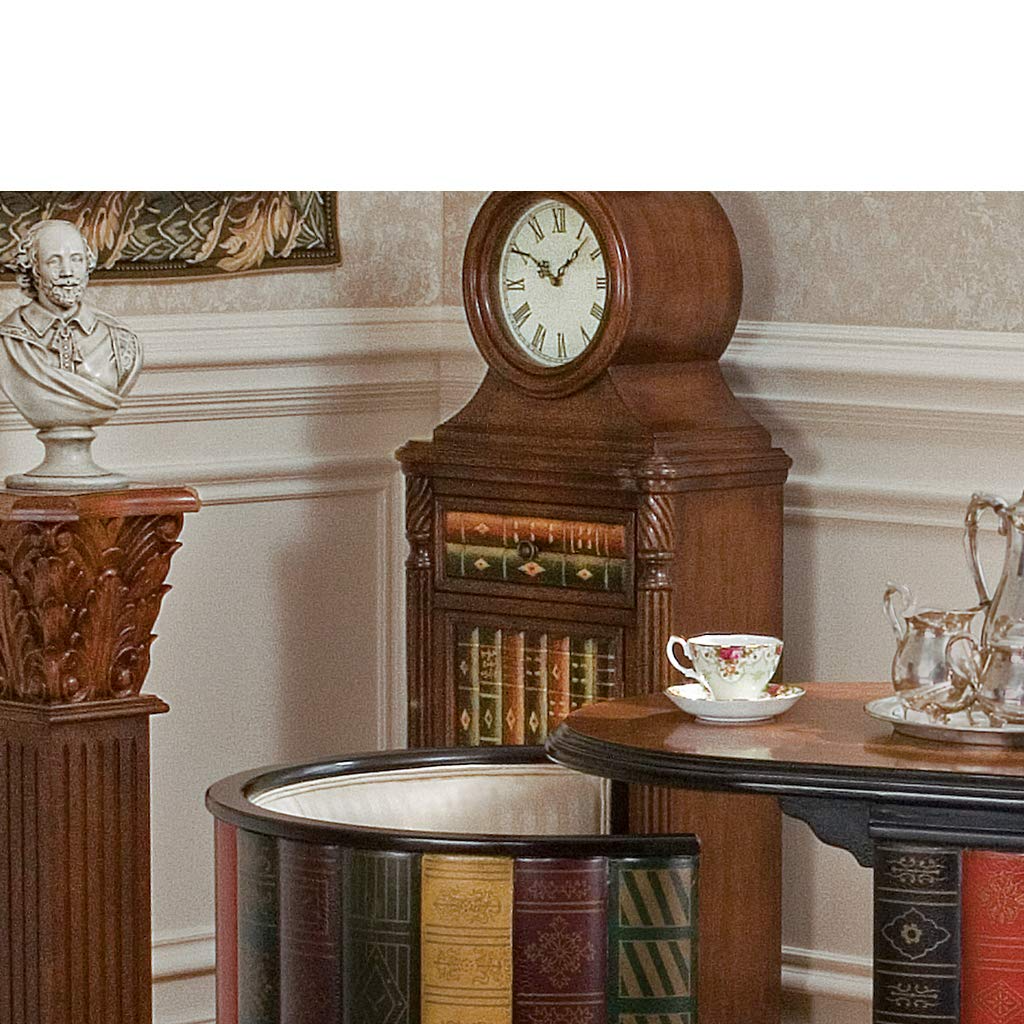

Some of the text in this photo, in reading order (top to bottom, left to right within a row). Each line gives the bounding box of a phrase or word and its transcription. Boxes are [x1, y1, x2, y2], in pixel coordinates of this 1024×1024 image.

[527, 216, 545, 243] XI
[552, 207, 566, 233] XII
[576, 220, 586, 239] I
[590, 247, 602, 261] II
[506, 278, 525, 291] IX
[596, 277, 607, 289] III
[513, 301, 532, 329] VIII
[533, 323, 547, 351] VII
[557, 333, 567, 358] VI
[580, 325, 592, 346] V
